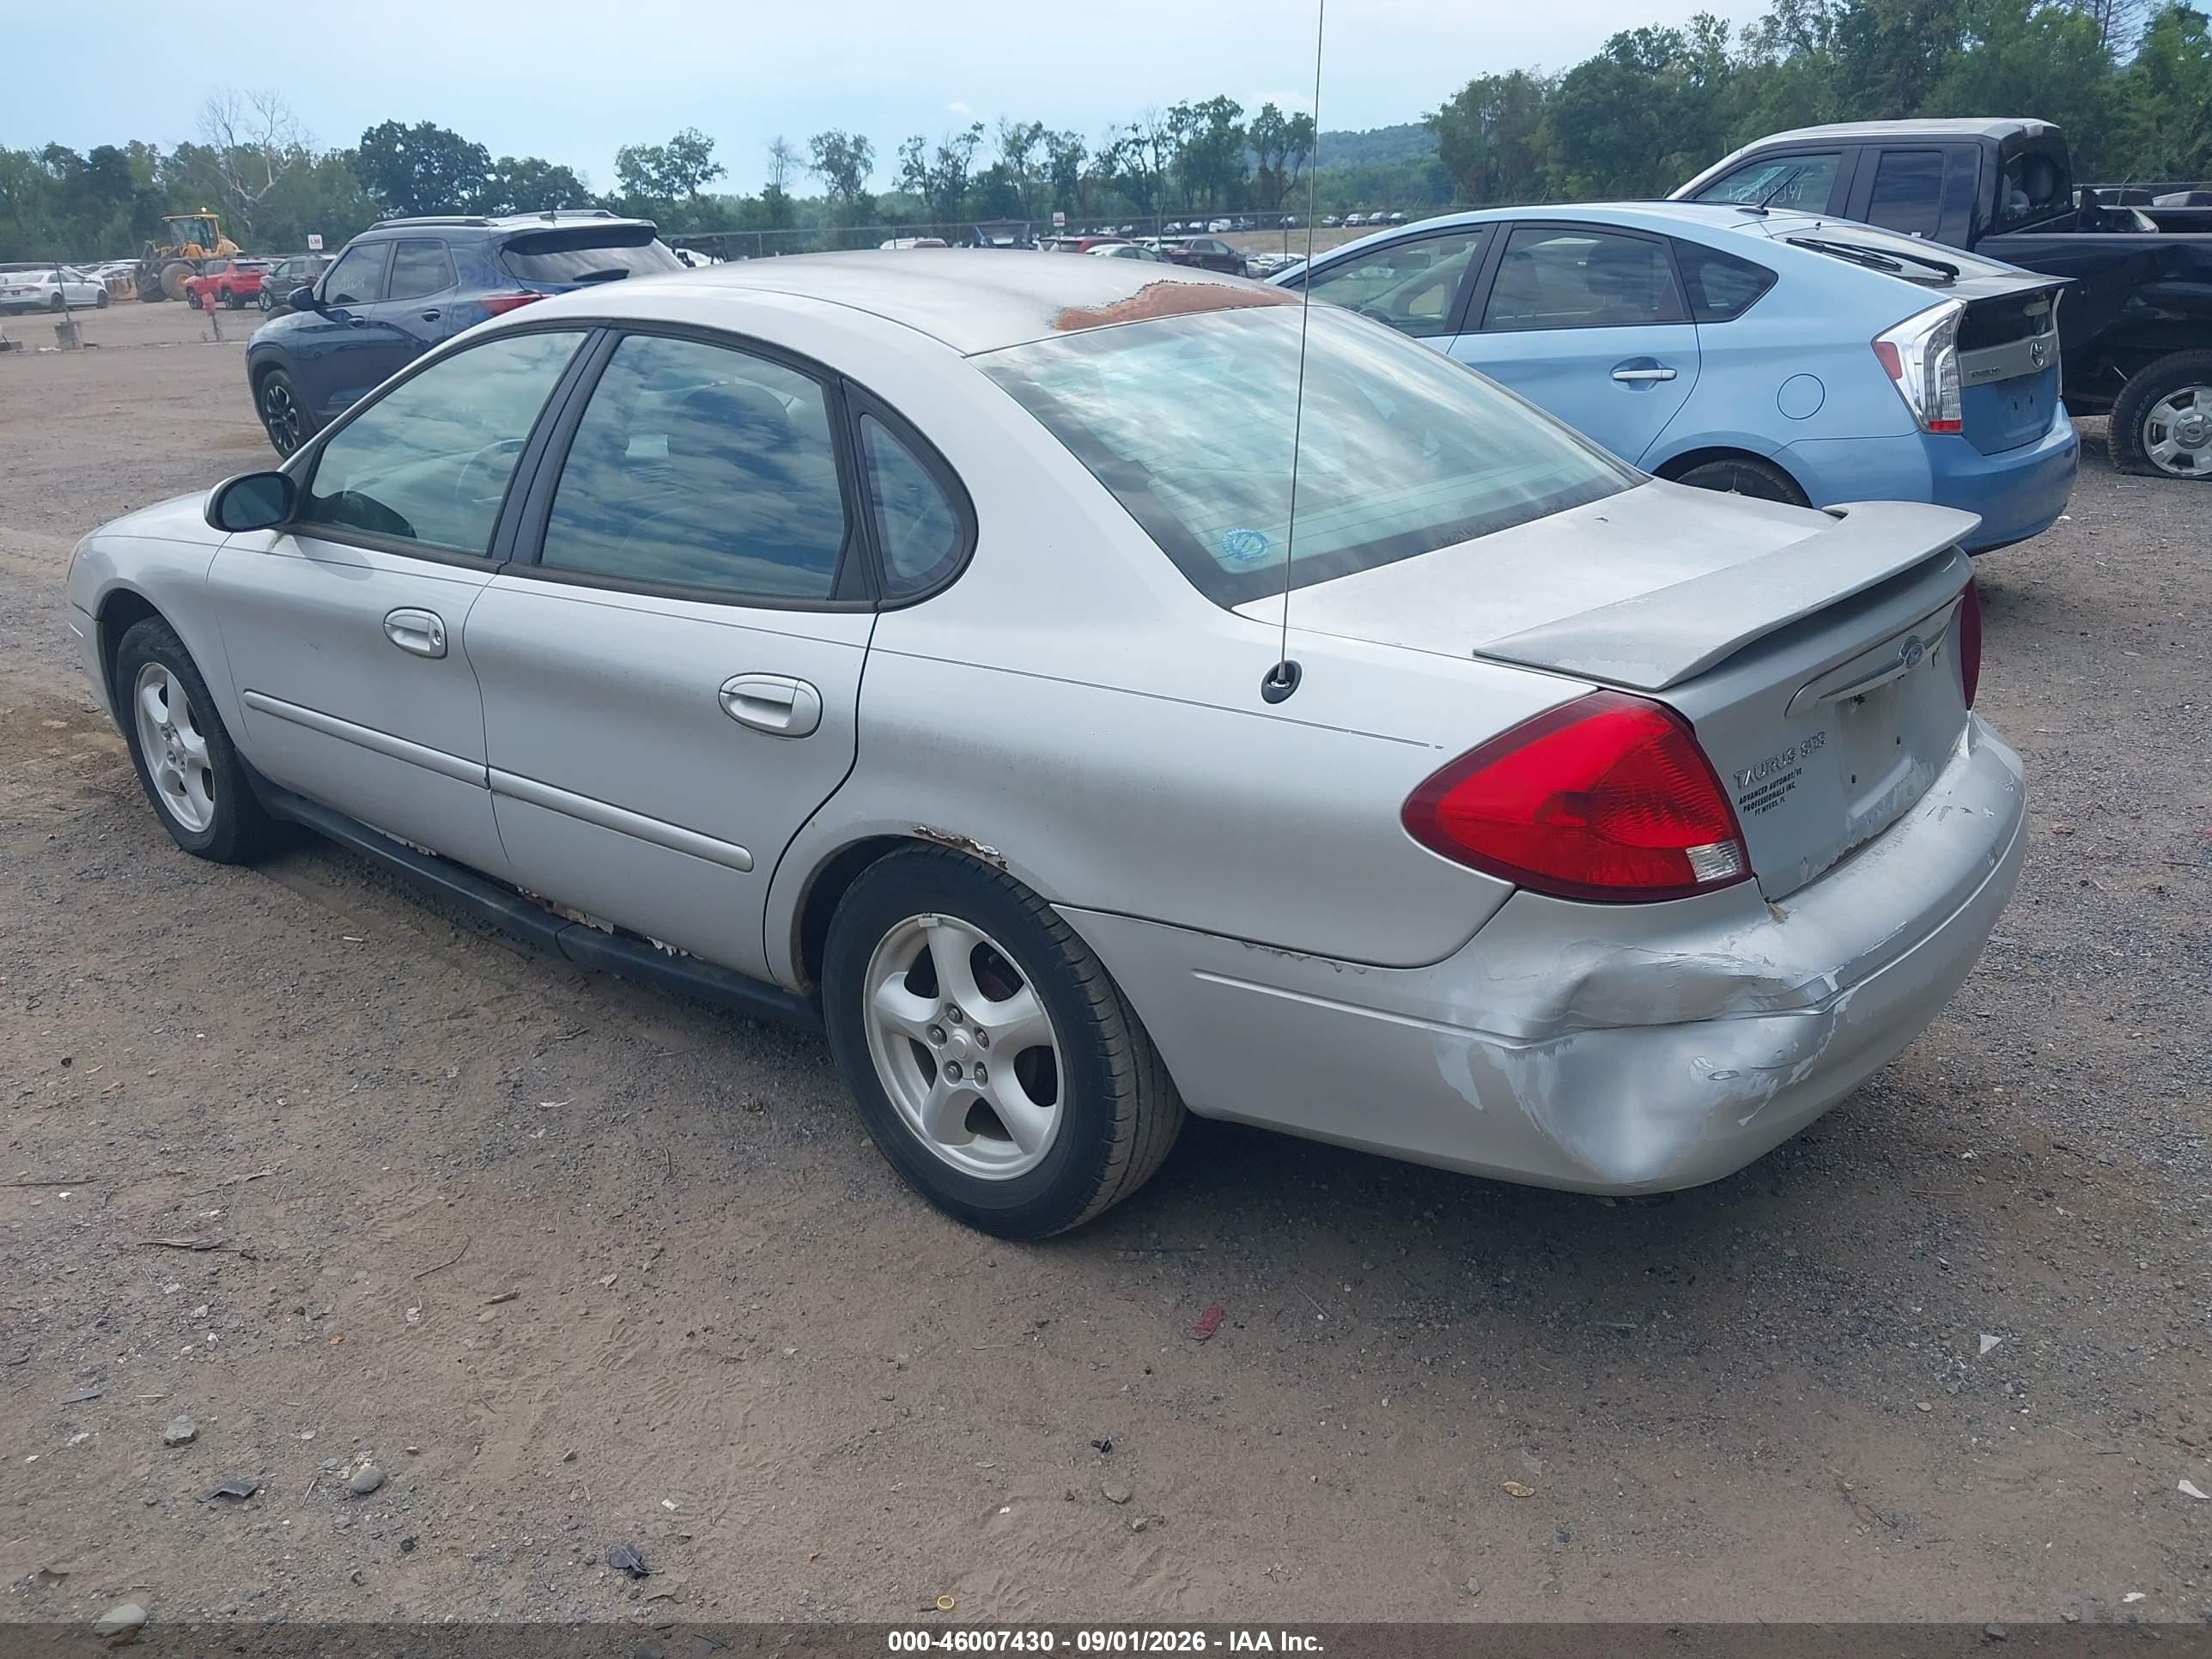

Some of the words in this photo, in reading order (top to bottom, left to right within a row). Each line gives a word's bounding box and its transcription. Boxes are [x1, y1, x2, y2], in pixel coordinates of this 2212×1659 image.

[1734, 747, 1796, 790] TAURUS
[1739, 785, 1768, 805] ADVANCED
[1769, 767, 1802, 791] AUTOMOTIVE
[1743, 786, 1785, 814] PROFESSIONALS
